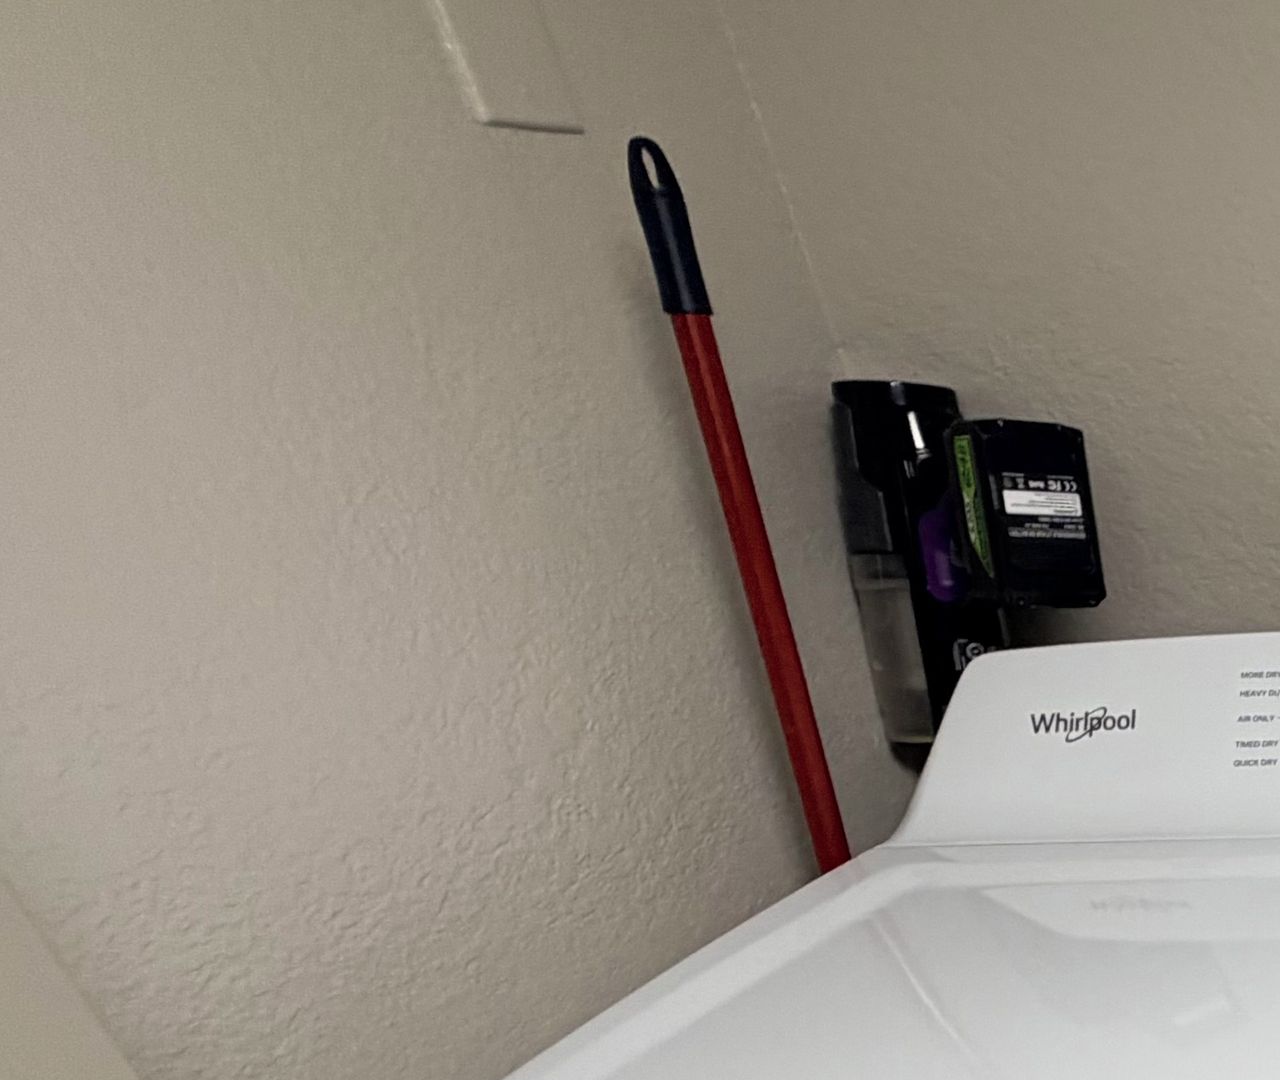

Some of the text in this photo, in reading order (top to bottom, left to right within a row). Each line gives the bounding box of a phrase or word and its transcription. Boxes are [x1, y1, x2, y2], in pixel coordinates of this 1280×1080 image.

[1240, 671, 1264, 679] MORE
[1239, 690, 1267, 698] HEAVY
[1030, 707, 1136, 741] Whirlpool
[1261, 740, 1279, 748] DRY
